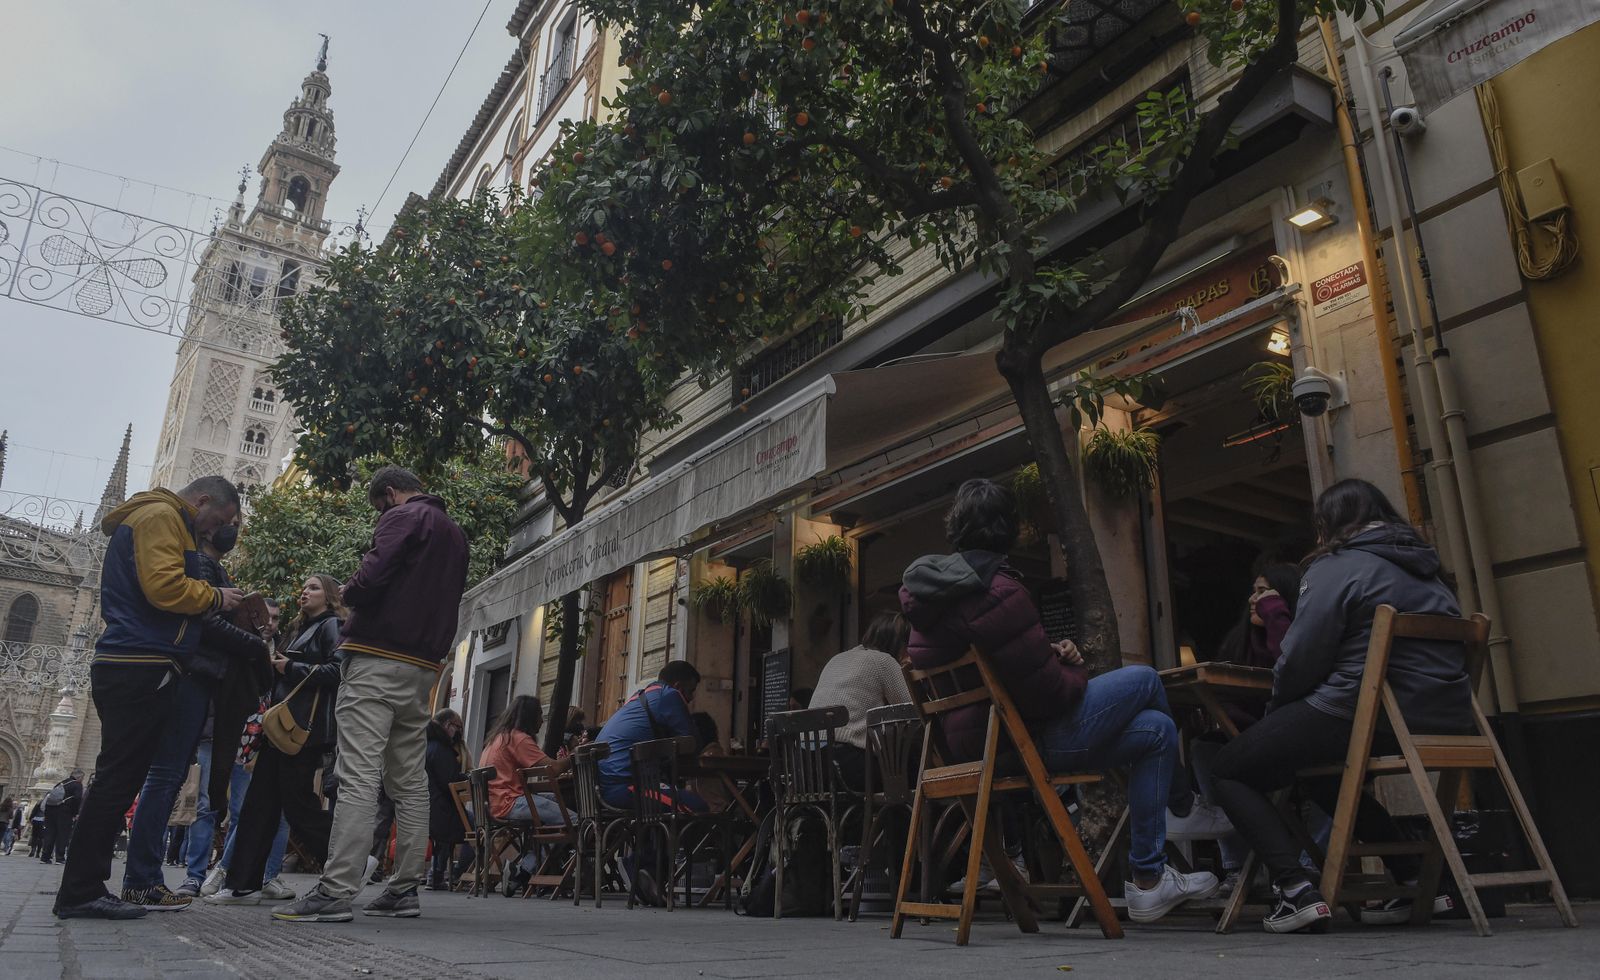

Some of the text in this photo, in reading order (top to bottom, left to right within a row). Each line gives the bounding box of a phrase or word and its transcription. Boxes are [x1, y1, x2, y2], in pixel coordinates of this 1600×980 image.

[1447, 13, 1536, 63] Cruzcampo
[1315, 264, 1359, 288] CONECTADA
[1174, 279, 1230, 311] TAPAS
[585, 530, 619, 568] Catedral
